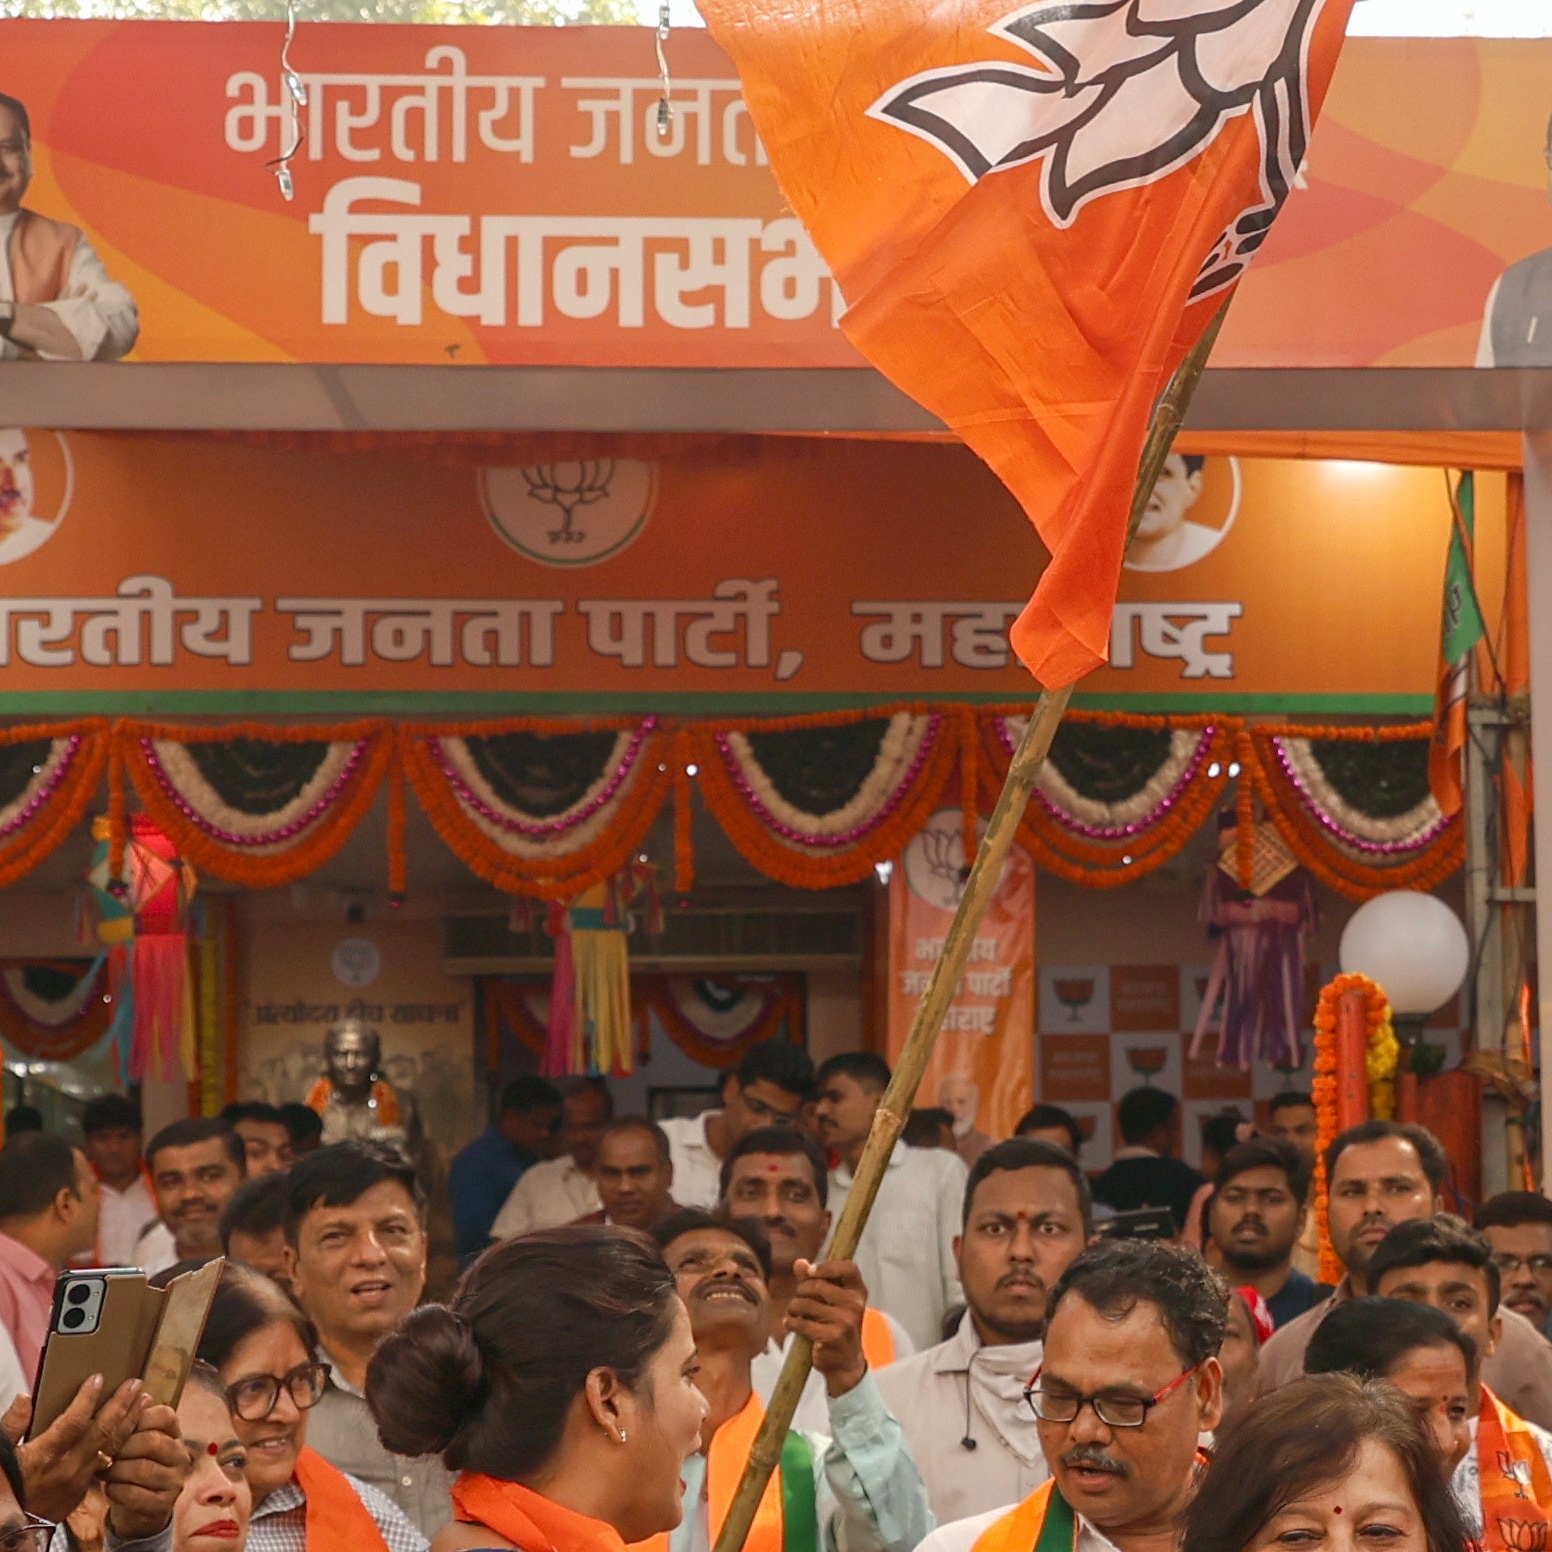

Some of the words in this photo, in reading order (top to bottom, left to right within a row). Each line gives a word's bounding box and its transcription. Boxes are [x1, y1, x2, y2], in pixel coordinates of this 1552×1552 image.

[224, 45, 546, 164] भारतीय
[309, 176, 847, 329] विधानसभ
[276, 598, 564, 668] जनता
[577, 578, 804, 682] पार्टी,
[851, 600, 1243, 679] महाष्ट्र
